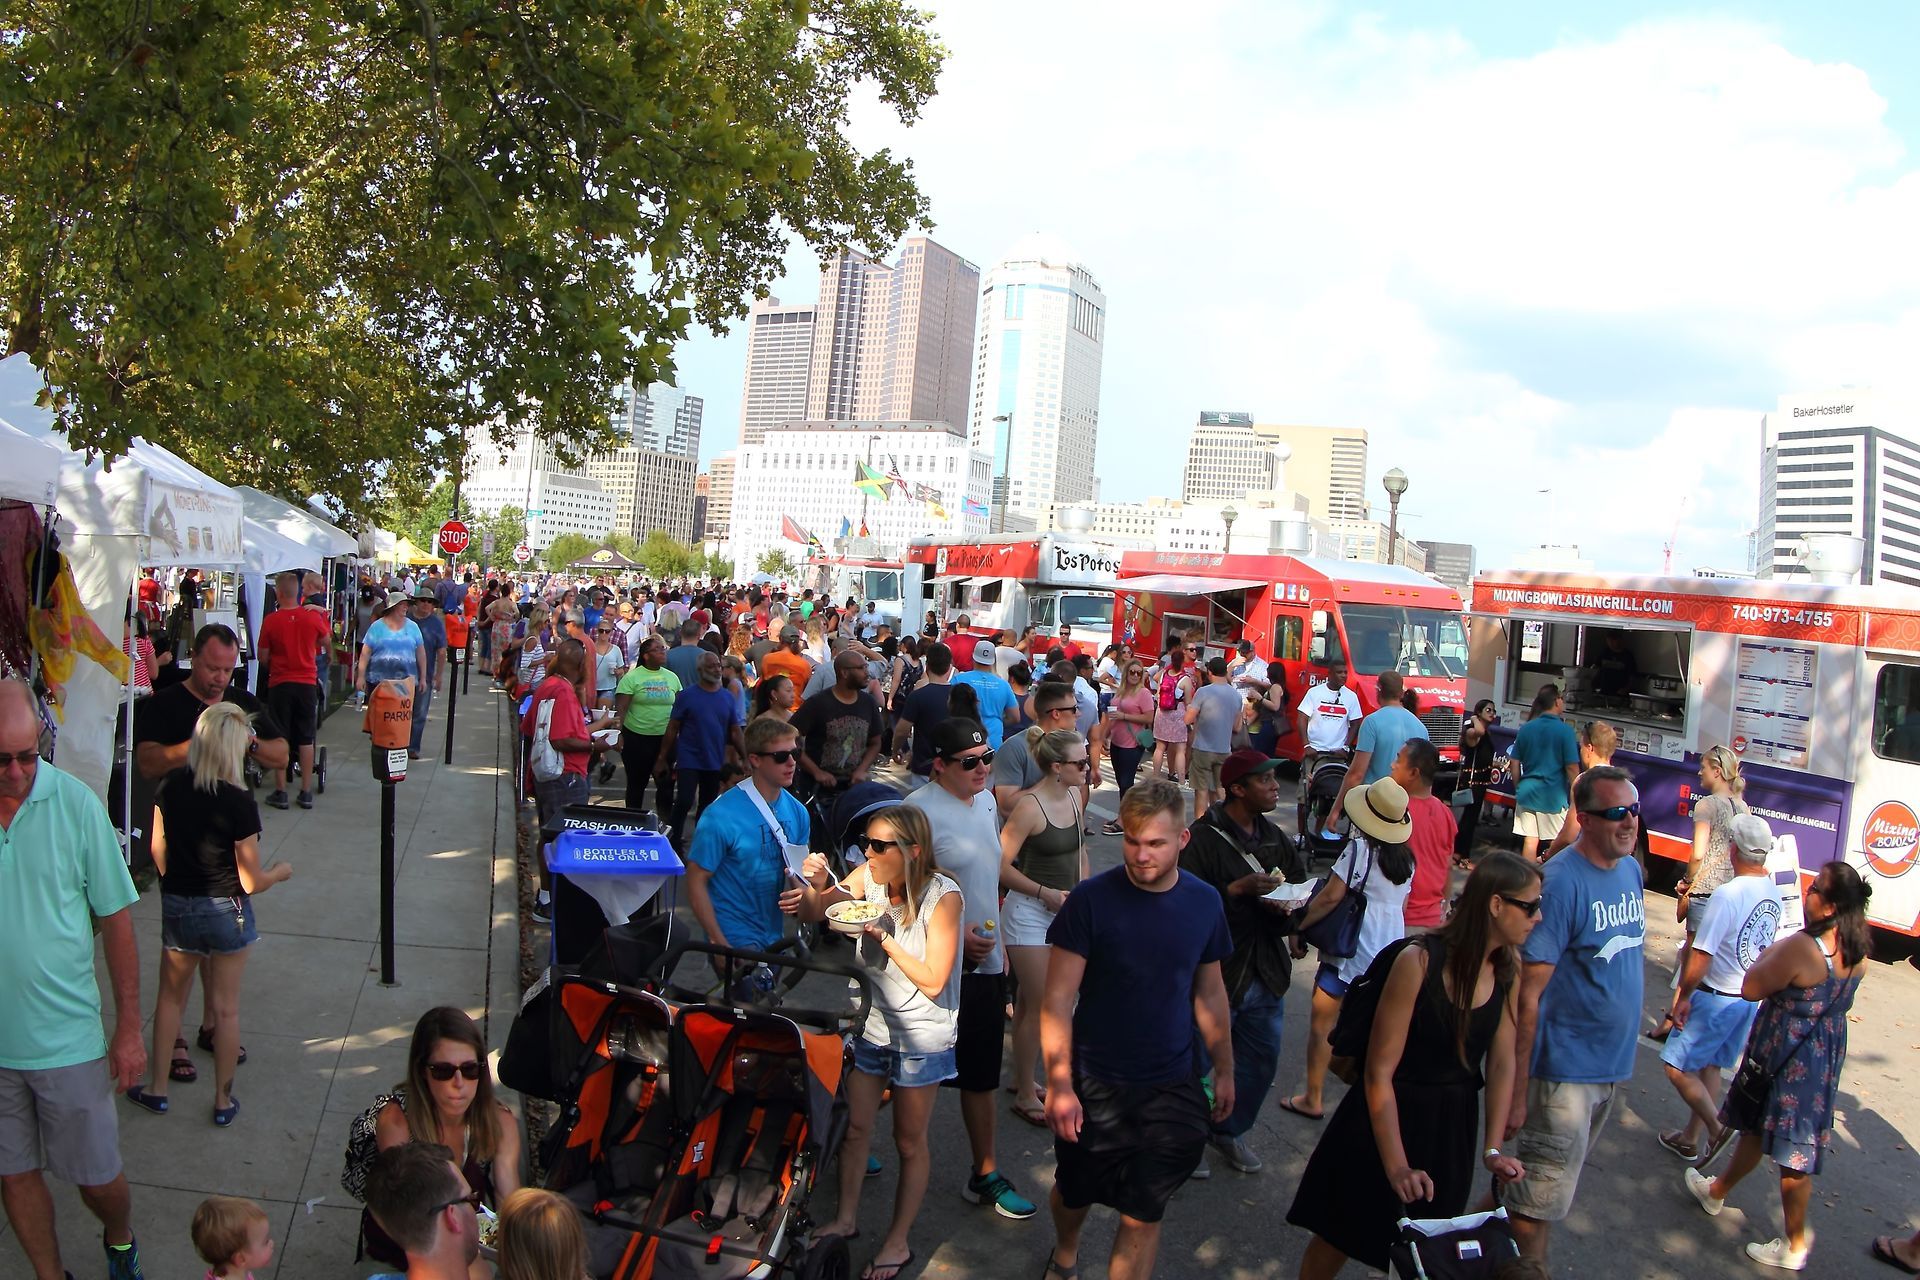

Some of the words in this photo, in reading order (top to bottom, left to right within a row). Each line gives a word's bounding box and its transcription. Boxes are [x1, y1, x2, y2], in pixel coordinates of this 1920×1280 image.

[1793, 404, 1854, 418] BakerHostetler
[440, 530, 468, 544] STOP
[1054, 546, 1078, 571] Los
[1493, 589, 1673, 614] MIXINGBOWLASIANGRILL.COM
[1732, 604, 1833, 627] 740-973-4755
[982, 649, 989, 657] C
[400, 700, 411, 709] NO
[563, 818, 607, 831] TRASH
[1866, 817, 1917, 843] Mixing
[1876, 837, 1909, 847] BOWL
[1592, 891, 1645, 932] Daddy
